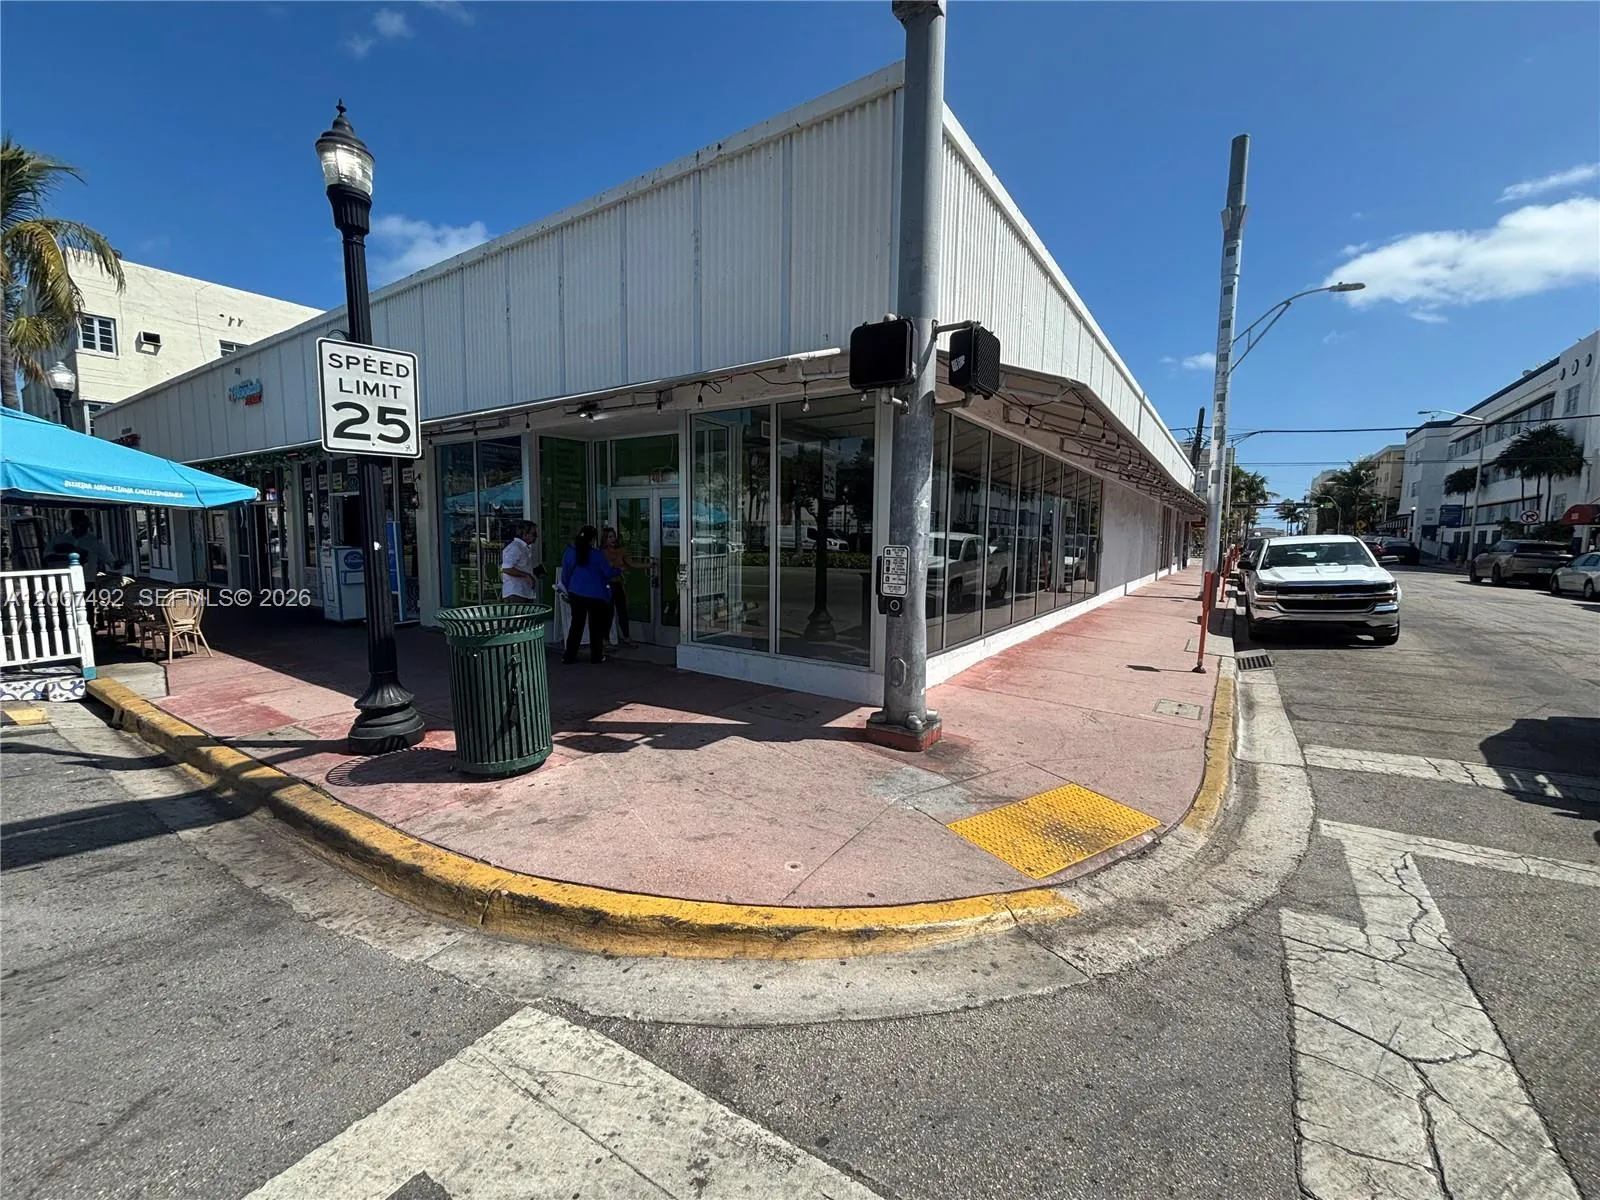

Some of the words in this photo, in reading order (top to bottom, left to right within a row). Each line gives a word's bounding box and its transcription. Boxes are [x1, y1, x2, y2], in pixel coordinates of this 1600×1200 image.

[328, 353, 409, 378] SPEED
[339, 378, 402, 399] LIMIT
[331, 401, 411, 444] 25
